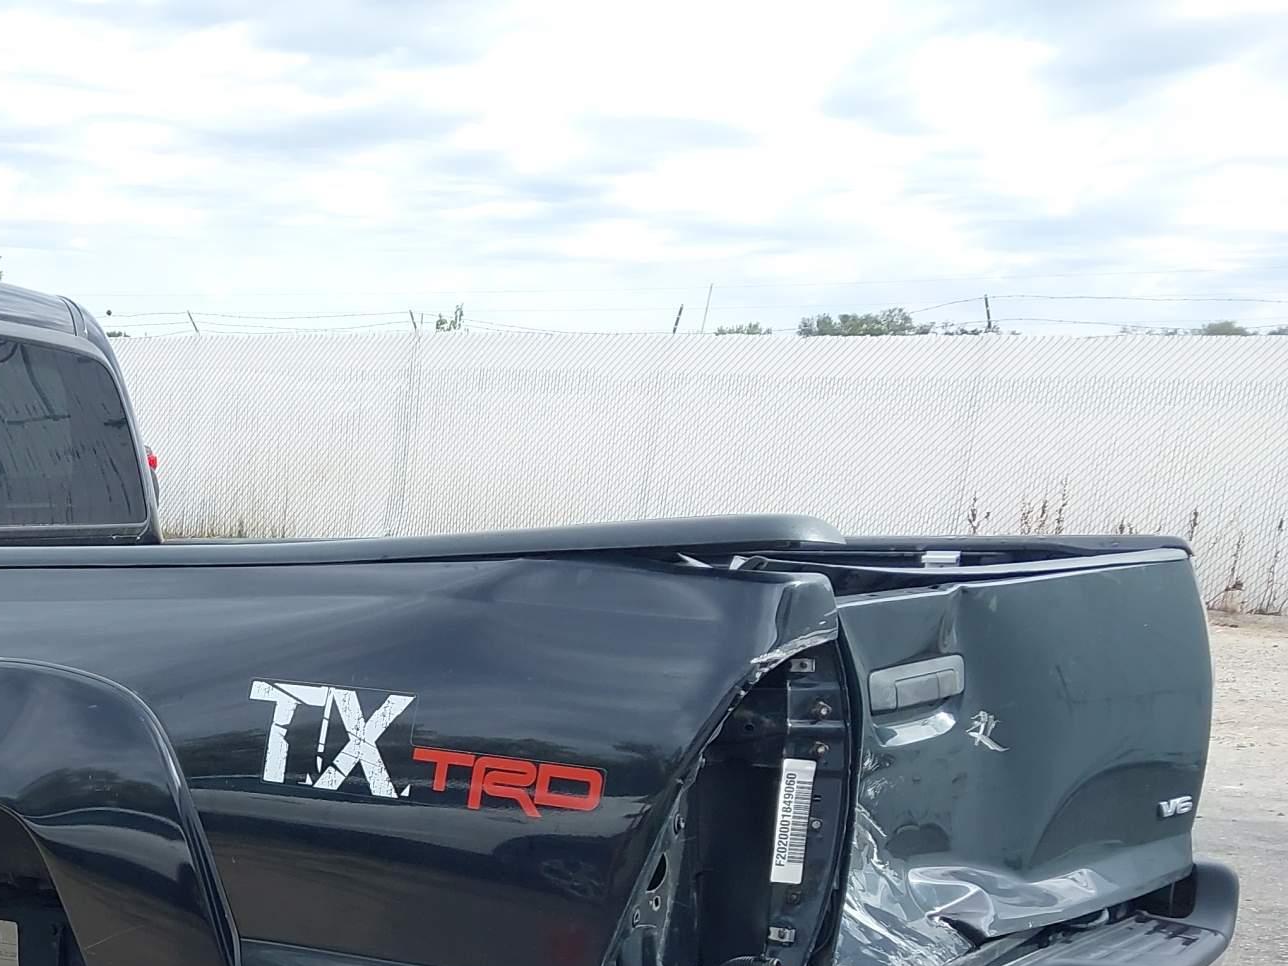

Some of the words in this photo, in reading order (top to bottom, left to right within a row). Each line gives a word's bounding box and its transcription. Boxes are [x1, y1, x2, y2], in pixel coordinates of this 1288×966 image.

[249, 680, 416, 799] TX
[413, 747, 605, 818] TRD
[775, 772, 797, 867] F2020001849060
[1158, 795, 1193, 818] V6
